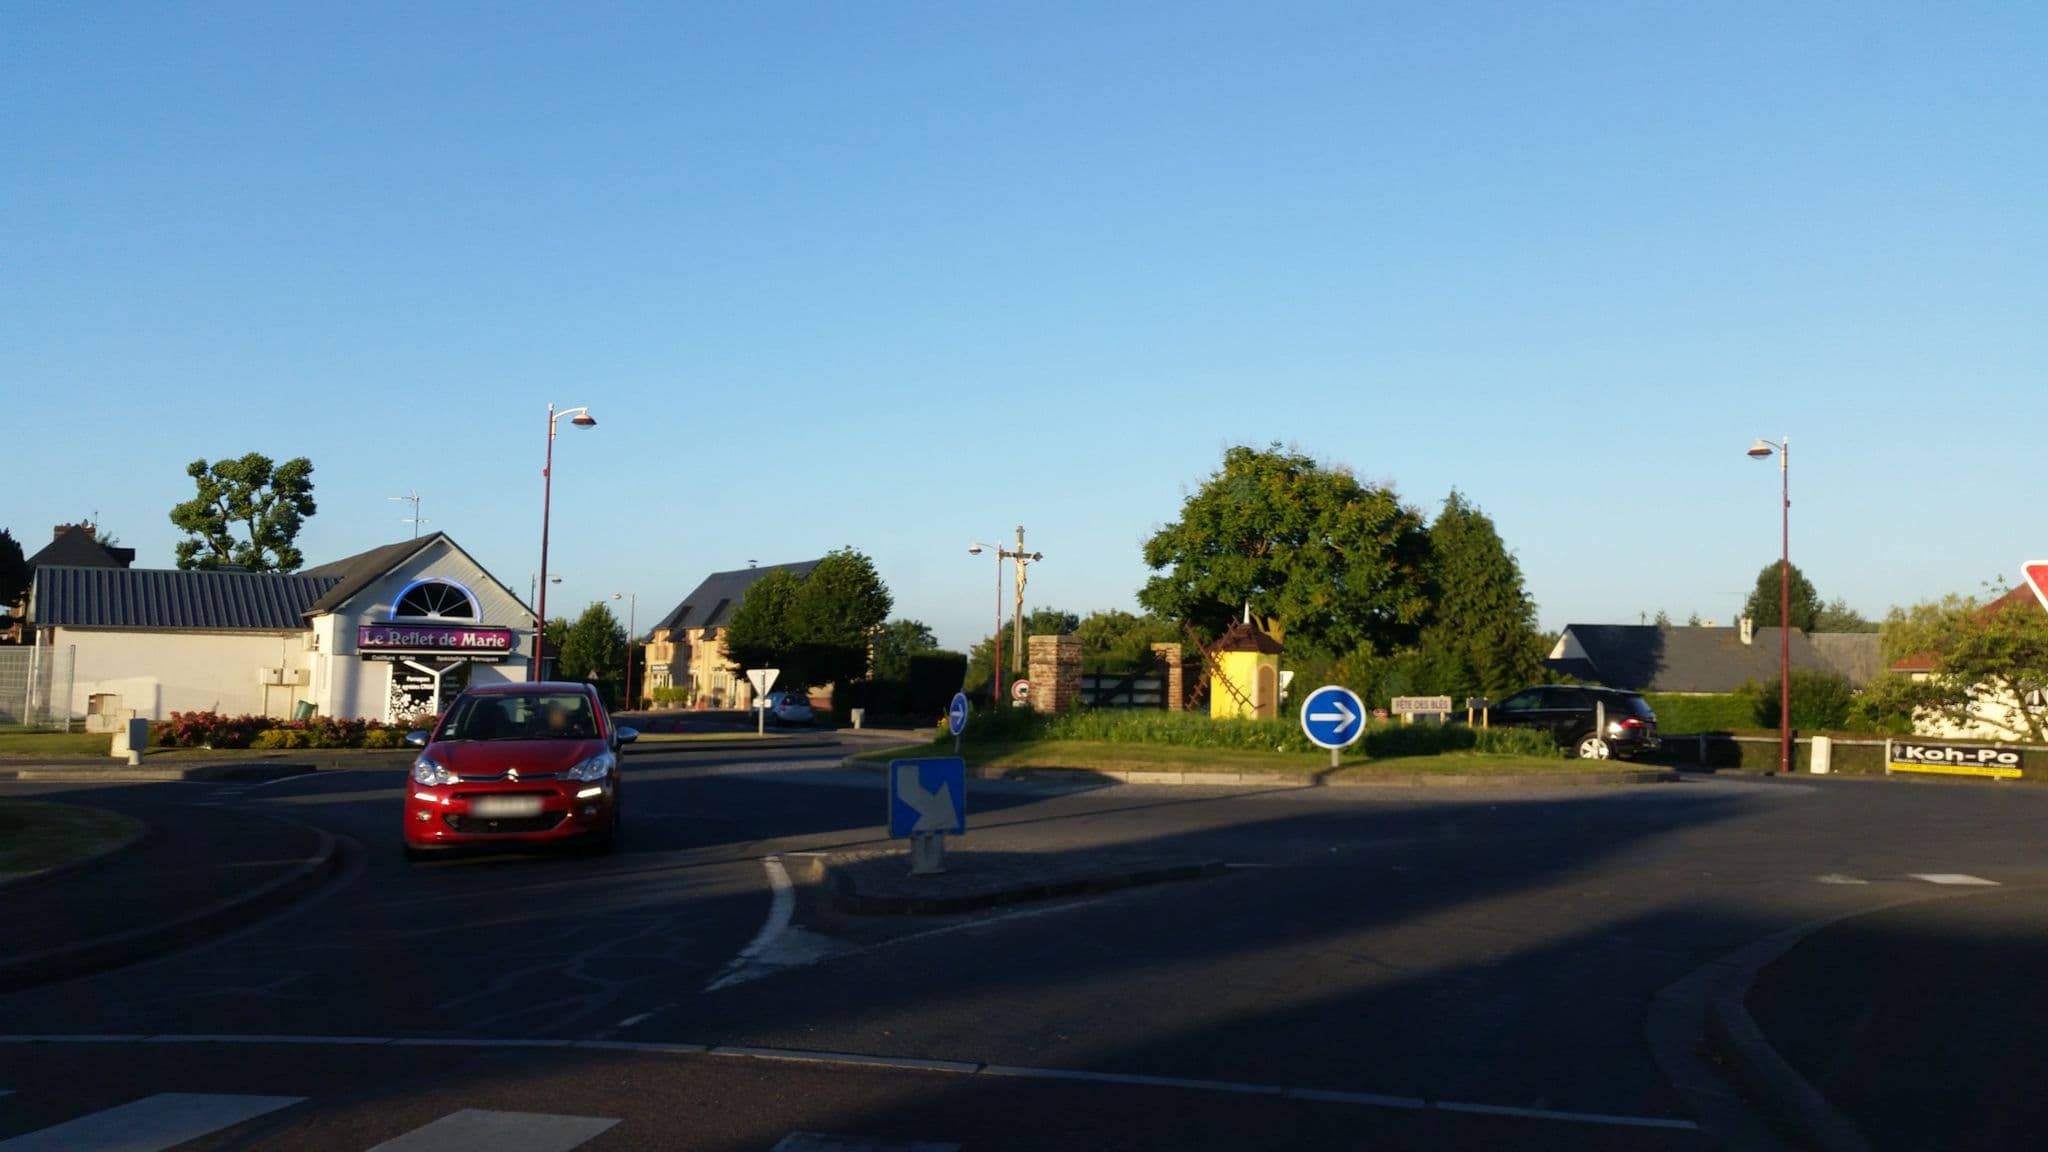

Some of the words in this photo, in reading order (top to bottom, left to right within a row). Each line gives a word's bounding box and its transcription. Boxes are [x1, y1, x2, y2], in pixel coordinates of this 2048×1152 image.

[364, 630, 384, 645] Le
[389, 630, 434, 646] Reflet
[439, 633, 457, 646] de
[461, 632, 505, 648] Marie
[1905, 745, 2019, 764] Koh-Po
